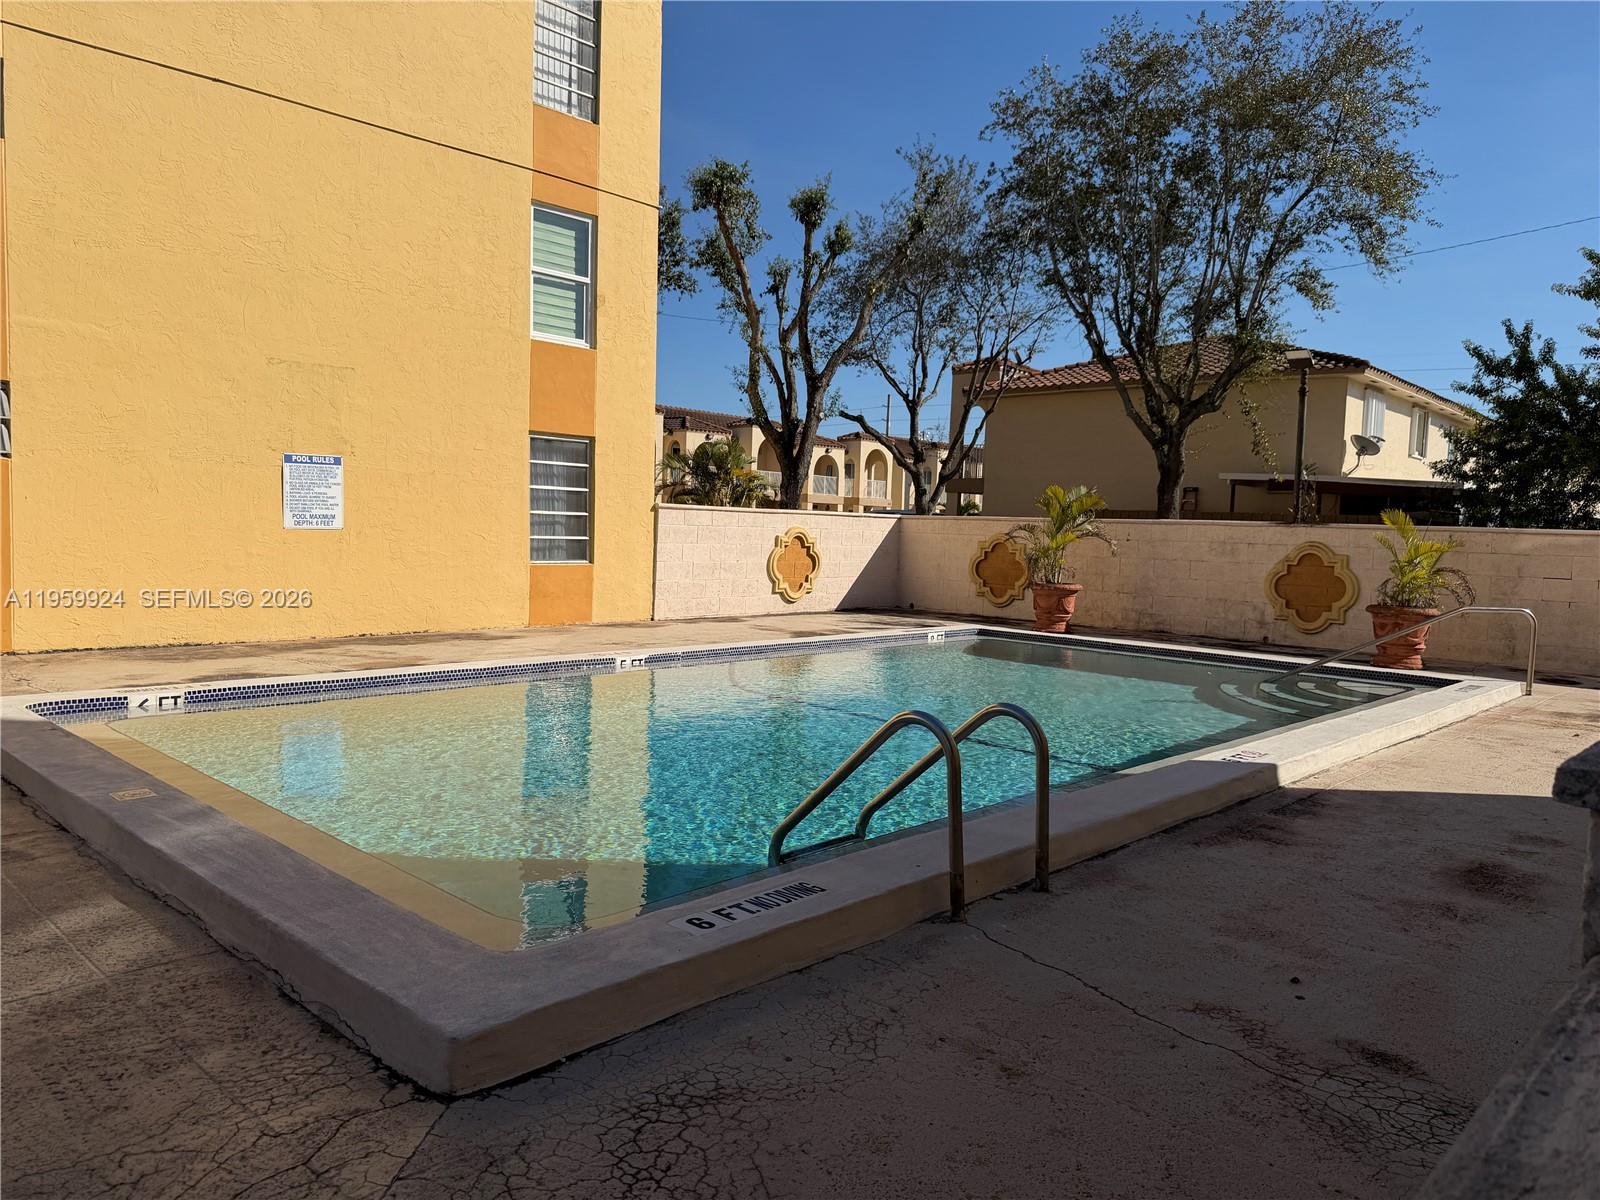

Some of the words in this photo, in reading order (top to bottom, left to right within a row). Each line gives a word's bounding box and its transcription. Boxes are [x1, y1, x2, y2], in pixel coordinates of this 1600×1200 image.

[292, 455, 311, 463] POOL
[312, 456, 335, 464] RULES
[685, 916, 716, 930] 6
[744, 896, 781, 910] NO
[763, 882, 827, 904] DIVING
